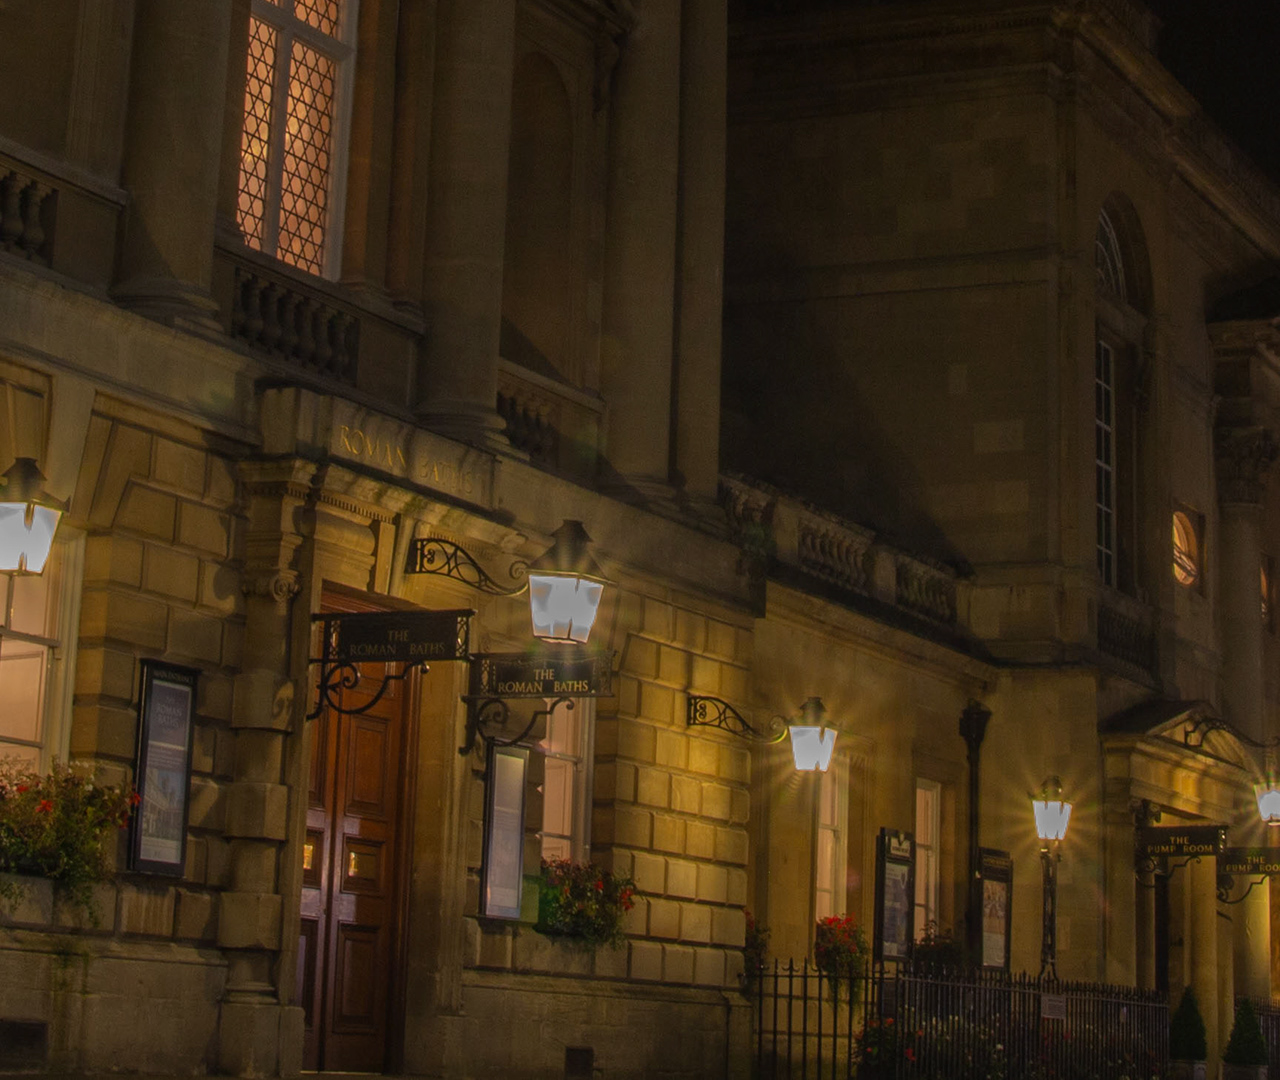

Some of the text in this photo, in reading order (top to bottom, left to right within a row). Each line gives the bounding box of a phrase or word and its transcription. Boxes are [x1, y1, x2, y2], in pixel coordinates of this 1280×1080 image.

[387, 630, 409, 641] THE
[349, 642, 446, 656] ROMAN BATHS
[533, 668, 555, 680] THE
[498, 680, 589, 693] ROMAN BATHS
[1170, 836, 1189, 844] THE
[1147, 844, 1213, 853] PUMP ROOM
[1246, 856, 1265, 864] THE
[1226, 864, 1254, 872] PUMP
